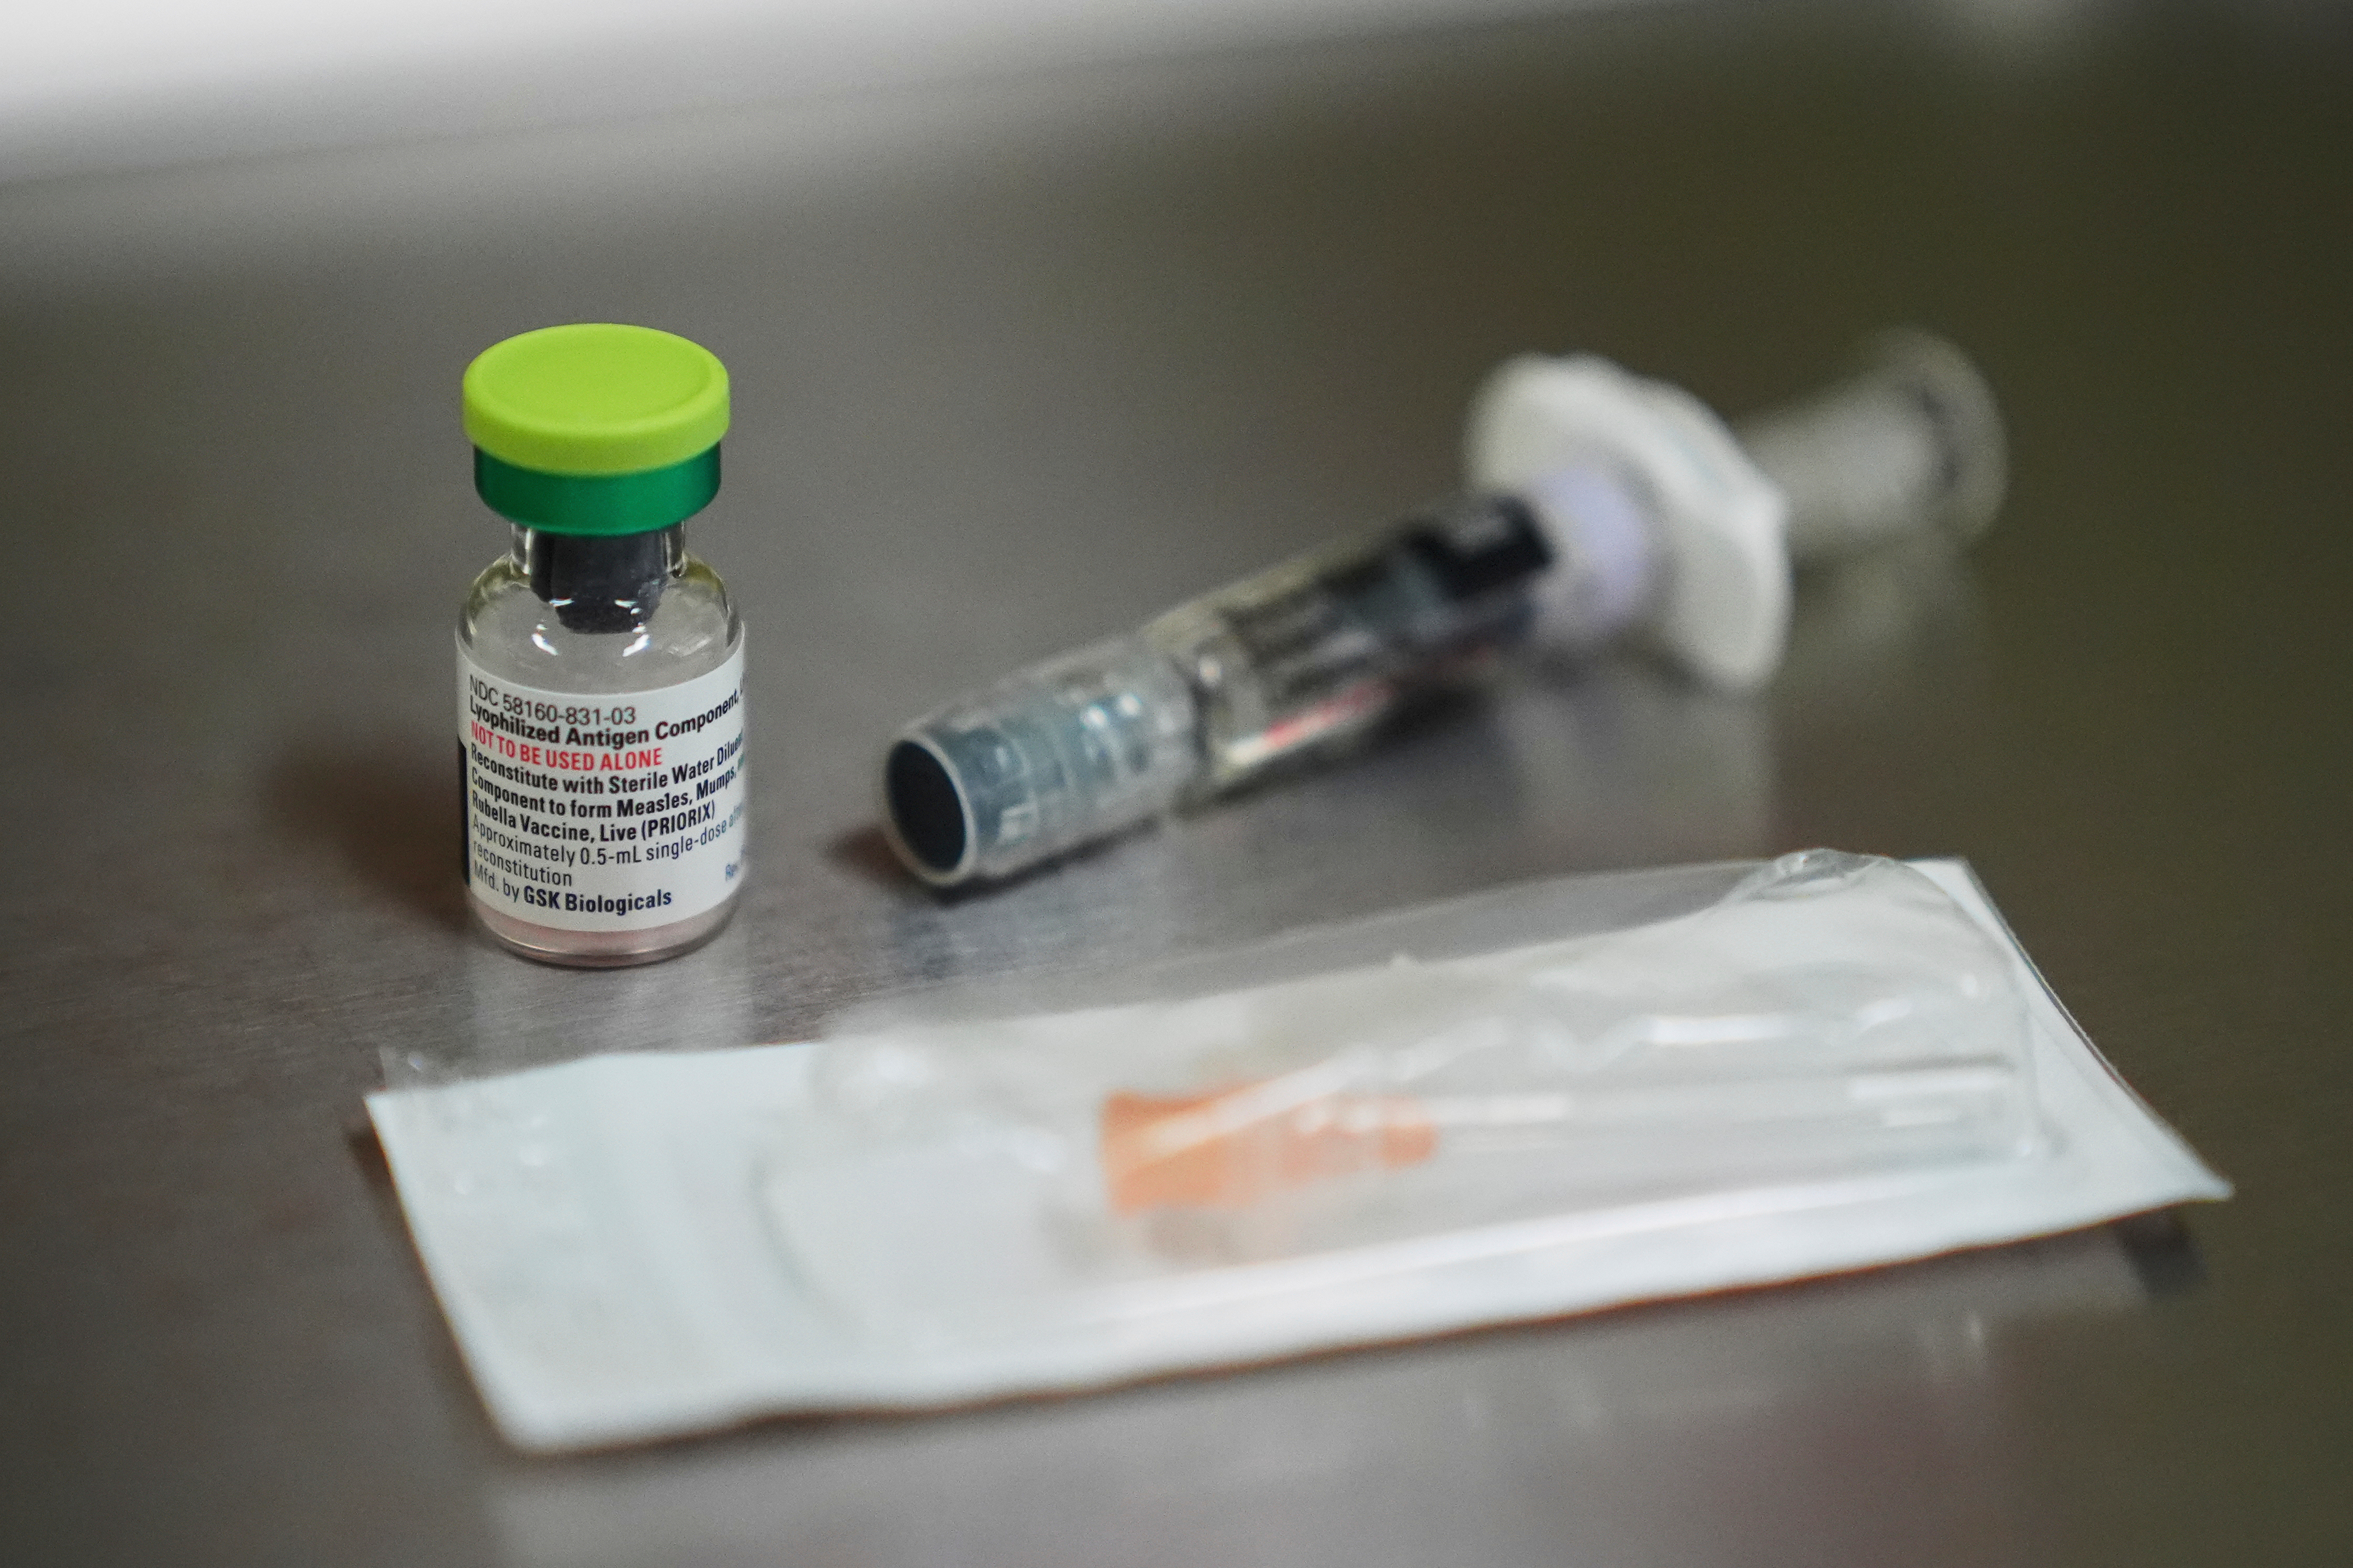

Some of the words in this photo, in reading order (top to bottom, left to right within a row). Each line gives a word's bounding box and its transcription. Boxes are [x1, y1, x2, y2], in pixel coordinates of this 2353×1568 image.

[470, 674, 498, 706] NDC
[503, 693, 636, 726] 58160-831-03
[470, 695, 559, 743] Lyophilized
[566, 727, 649, 750] Antigen
[655, 689, 738, 740] Component,
[472, 720, 494, 748] NOT
[497, 735, 515, 758] TO
[520, 744, 541, 765] BE
[546, 749, 595, 771] USED
[600, 748, 662, 771] ALONE
[472, 742, 558, 791] Reconstitute
[563, 776, 603, 794] with
[609, 771, 668, 794] Sterile
[672, 757, 714, 784] Water
[472, 766, 545, 813] Component
[549, 799, 565, 816] to
[570, 799, 611, 818] form
[617, 792, 692, 817] Measles,
[697, 766, 736, 800] Mumps,
[473, 789, 516, 828] Rubella
[520, 813, 596, 843] Vaccine,
[600, 824, 636, 841] Live
[641, 799, 715, 841] (PRIORIX)
[473, 813, 575, 867] Approximately
[580, 845, 642, 865] 0.5-mL
[646, 820, 726, 860] single-dose
[474, 840, 572, 886] reconstitution
[474, 860, 498, 892] Mfd.
[503, 877, 519, 903] by
[524, 885, 560, 909] GSK
[565, 889, 671, 916] Biologicals
